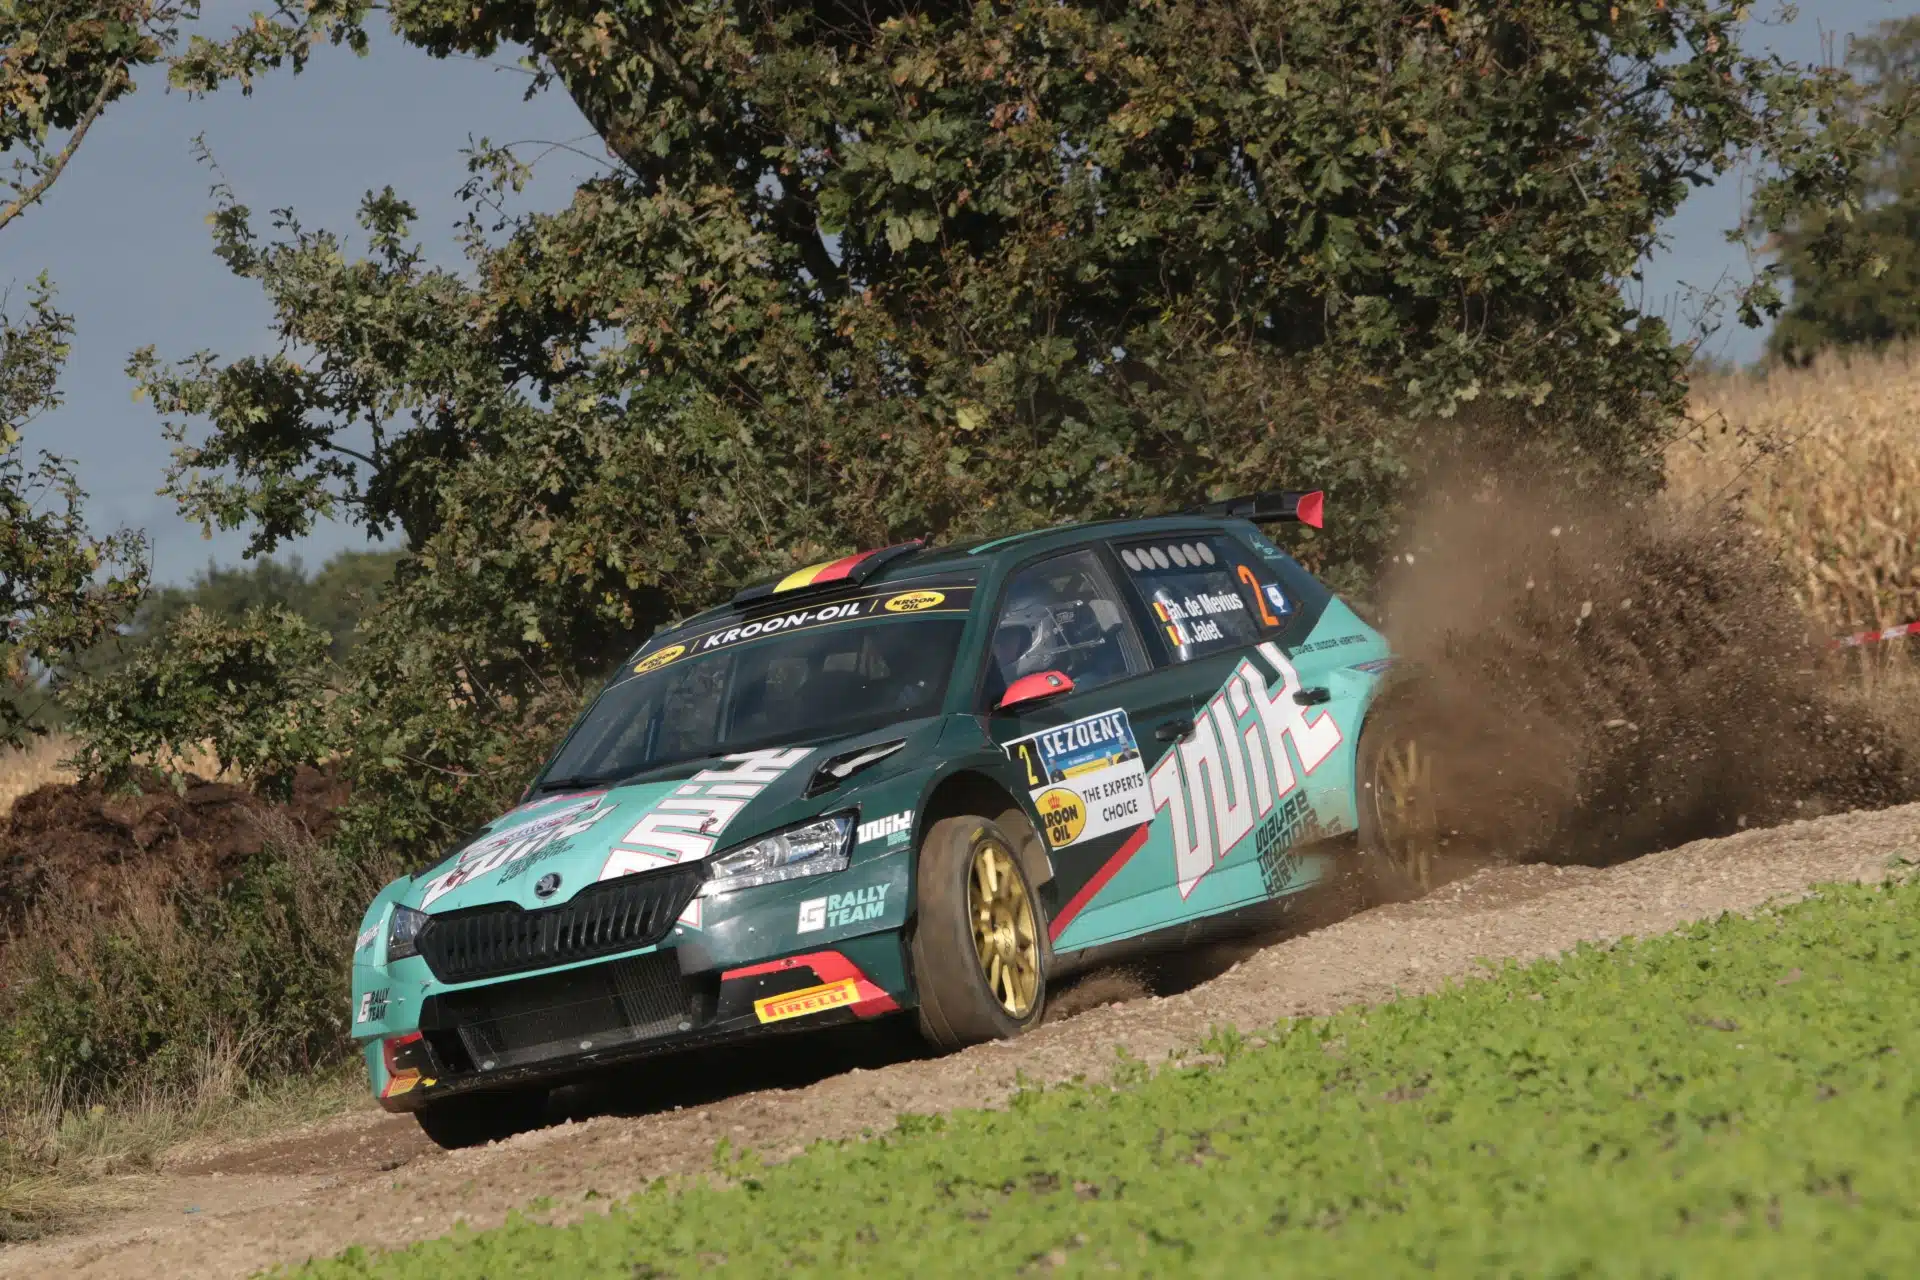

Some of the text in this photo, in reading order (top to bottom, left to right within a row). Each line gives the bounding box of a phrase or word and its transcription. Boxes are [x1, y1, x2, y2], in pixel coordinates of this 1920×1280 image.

[893, 596, 937, 606] KROON
[1184, 596, 1203, 617] de
[1197, 590, 1244, 615] Mevius
[1237, 564, 1280, 626] 2
[703, 602, 860, 649] KROON-OIL
[1191, 620, 1224, 643] Jalet
[1043, 714, 1125, 758] SEZOENS
[1018, 744, 1039, 785] 2
[1082, 788, 1101, 804] THE
[1102, 799, 1138, 822] CHOICE
[1053, 826, 1071, 843] OIL
[827, 883, 891, 911] RALLY
[827, 901, 885, 927] TEAM
[371, 988, 390, 1004] RALLY
[764, 985, 849, 1017] PIRELLI
[368, 1005, 387, 1022] TEAM
